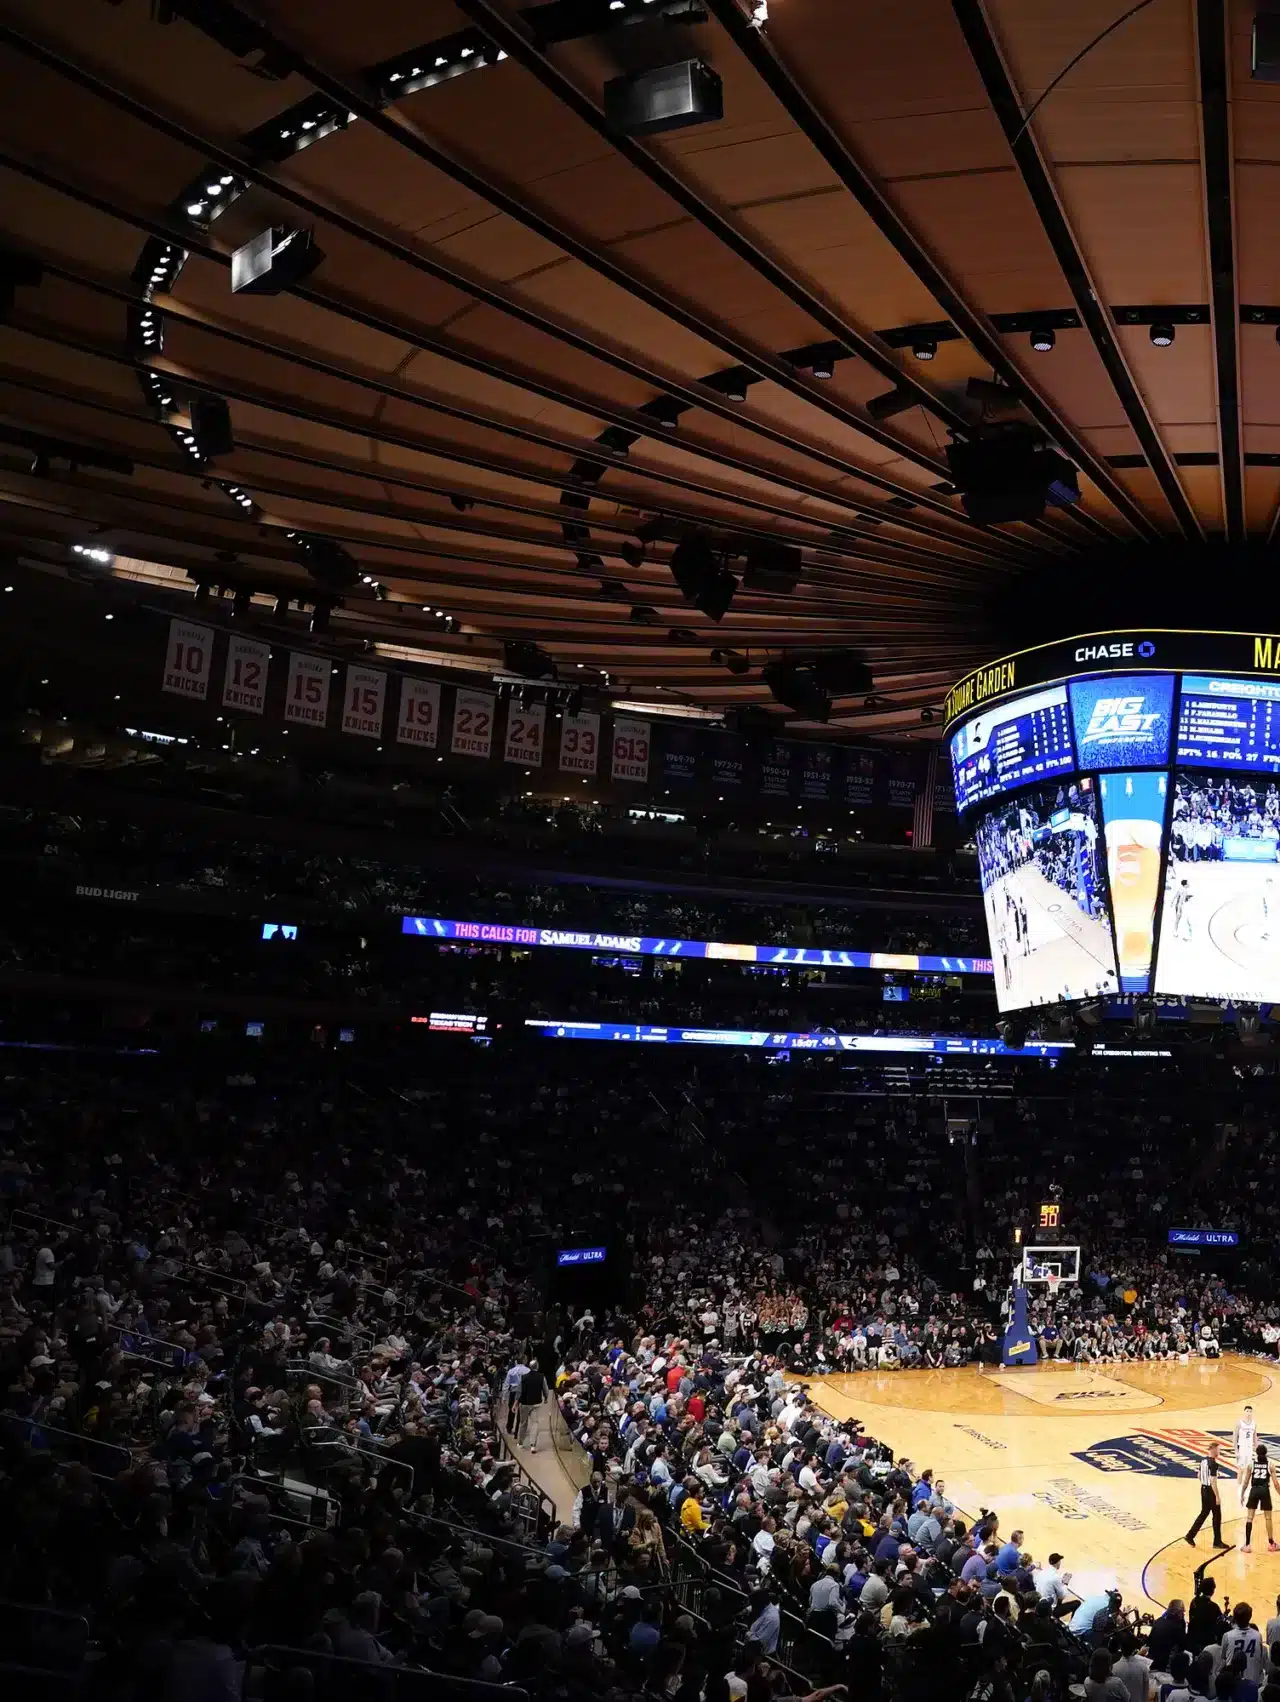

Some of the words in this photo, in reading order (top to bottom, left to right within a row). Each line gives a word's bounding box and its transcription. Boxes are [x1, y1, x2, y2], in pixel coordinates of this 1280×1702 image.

[173, 643, 203, 674] 10
[1075, 643, 1134, 662] CHASE
[232, 658, 261, 690] 12
[976, 661, 1015, 701] GARDEN
[166, 674, 206, 694] KNICKS
[293, 674, 323, 703] 15
[225, 689, 262, 709] KNICKS
[351, 686, 378, 716] 15
[1095, 697, 1145, 714] BIG
[287, 703, 325, 723] KNICKS
[406, 698, 433, 726] 19
[344, 715, 381, 733] KNICKS
[456, 709, 490, 737] 22
[511, 719, 539, 746] 24
[1087, 714, 1160, 734] EAST
[400, 727, 435, 744] KNICKS
[564, 729, 595, 755] 33
[454, 738, 489, 753] KNICKS
[507, 746, 541, 762] KNICKS
[614, 737, 648, 763] 613
[561, 756, 595, 771] KNICKS
[613, 763, 647, 778] KNICKS
[76, 885, 102, 897] BUD
[103, 889, 140, 901] LIGHT
[455, 923, 479, 938] THIS
[481, 925, 514, 942] CALLS
[516, 929, 537, 943] FOR
[540, 930, 592, 946] SAMUEL
[595, 935, 641, 952] ADAMS
[972, 960, 993, 972] THIS
[791, 1038, 819, 1048] 15:07
[822, 1036, 837, 1046] 46
[1040, 1214, 1057, 1227] 30
[1206, 1234, 1234, 1243] ULTRA
[583, 1251, 603, 1260] ULTRA
[1253, 1469, 1267, 1479] 22
[1233, 1638, 1257, 1658] 24
